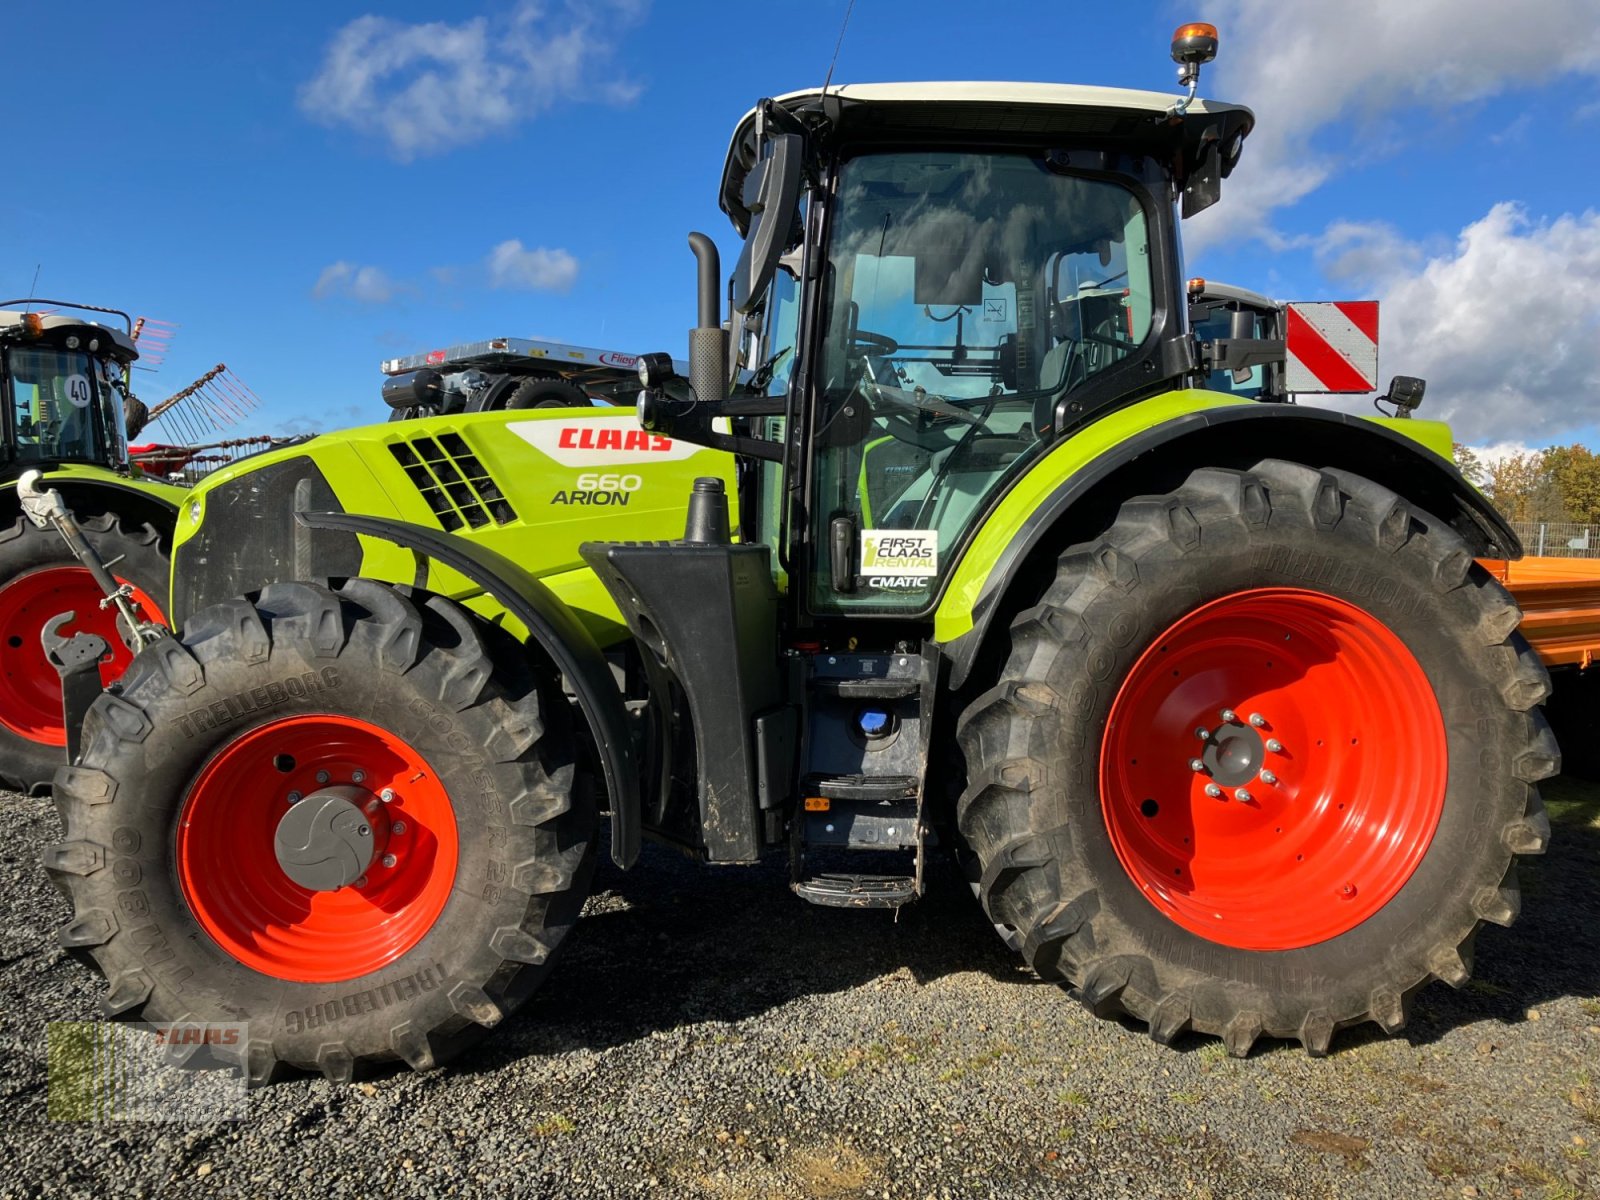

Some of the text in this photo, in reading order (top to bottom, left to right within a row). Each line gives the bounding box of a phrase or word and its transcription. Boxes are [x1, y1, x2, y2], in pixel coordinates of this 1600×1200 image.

[71, 380, 88, 401] 40
[558, 428, 672, 451] CLAAS
[576, 473, 642, 492] 660
[550, 490, 630, 505] ARION
[879, 537, 926, 548] FIRST
[877, 548, 933, 558] CLAAS
[873, 558, 936, 568] RENTAL
[869, 576, 929, 587] CMATIC
[1249, 543, 1436, 620] TRELLEBORG
[169, 665, 343, 739] TRELLEBORG
[284, 960, 450, 1035] TRELLEBORG
